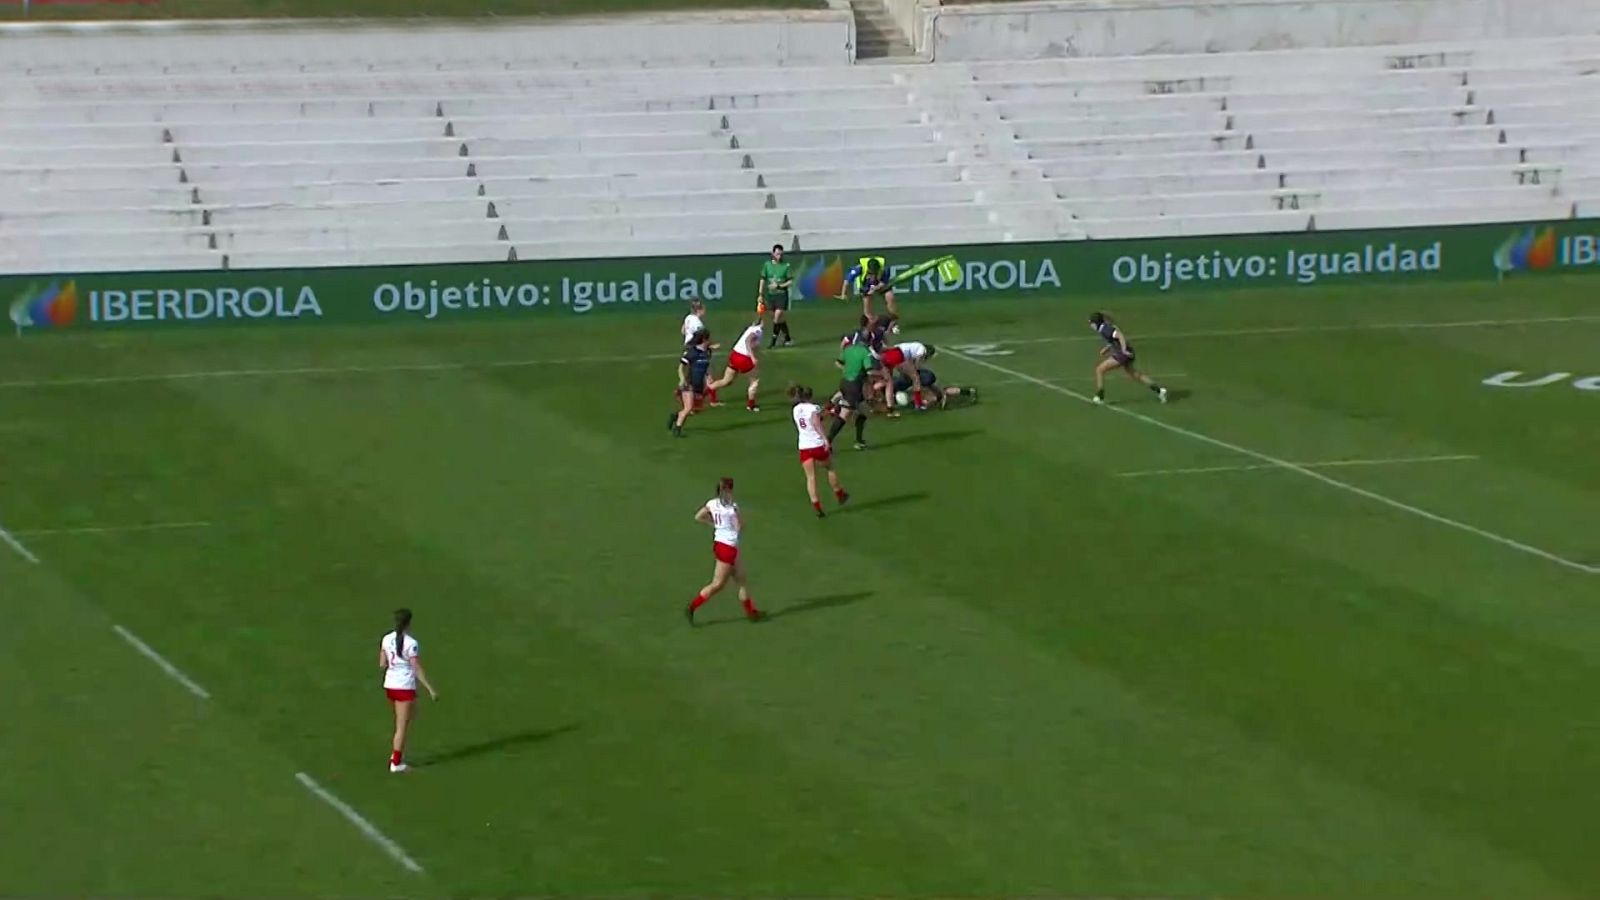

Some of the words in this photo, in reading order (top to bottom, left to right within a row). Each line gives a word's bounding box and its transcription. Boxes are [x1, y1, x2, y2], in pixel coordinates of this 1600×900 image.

[1112, 250, 1277, 290] Objetivo:
[1286, 242, 1442, 283] Igualdad
[1561, 234, 1600, 265] IB
[88, 285, 323, 322] IBERDROLA
[373, 278, 551, 318] Objetivo:
[561, 270, 724, 313] Igualdad
